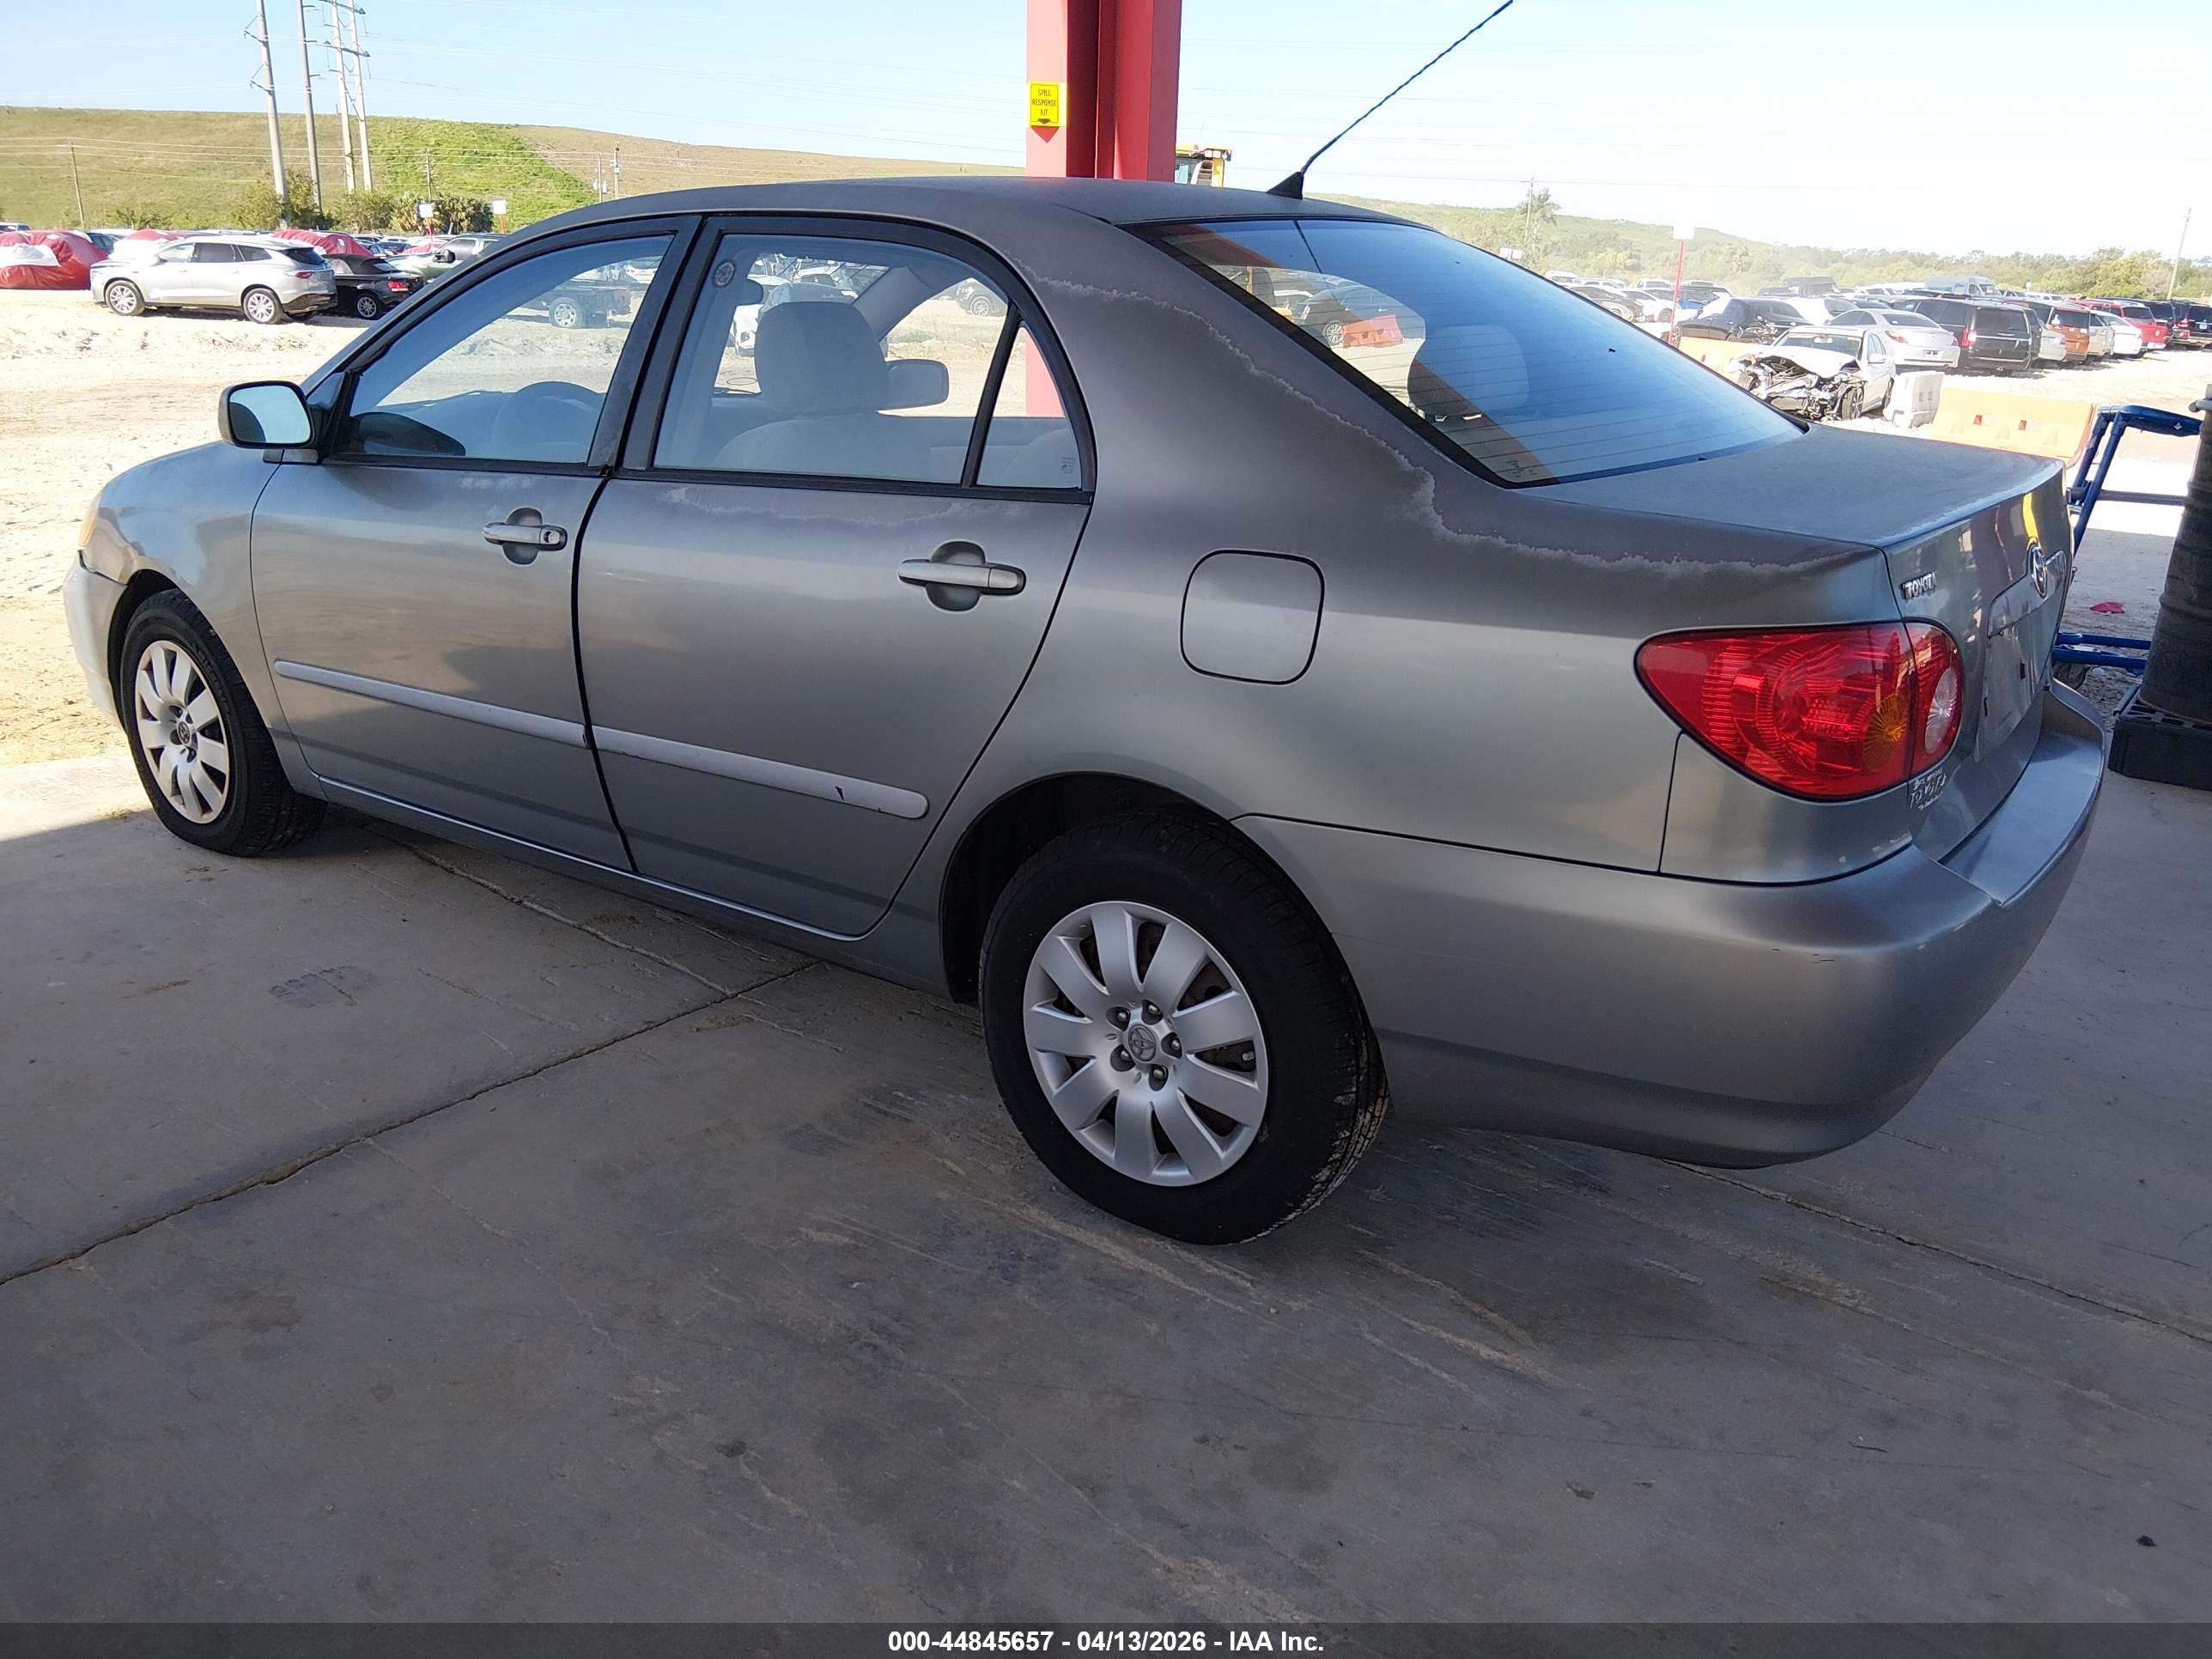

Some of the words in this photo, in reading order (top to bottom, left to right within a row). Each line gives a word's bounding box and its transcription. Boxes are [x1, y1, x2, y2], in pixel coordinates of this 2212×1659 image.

[1037, 88, 1052, 97] SPILL
[1031, 98, 1056, 107] RESPONSE
[1901, 571, 1937, 599] TOYOTA
